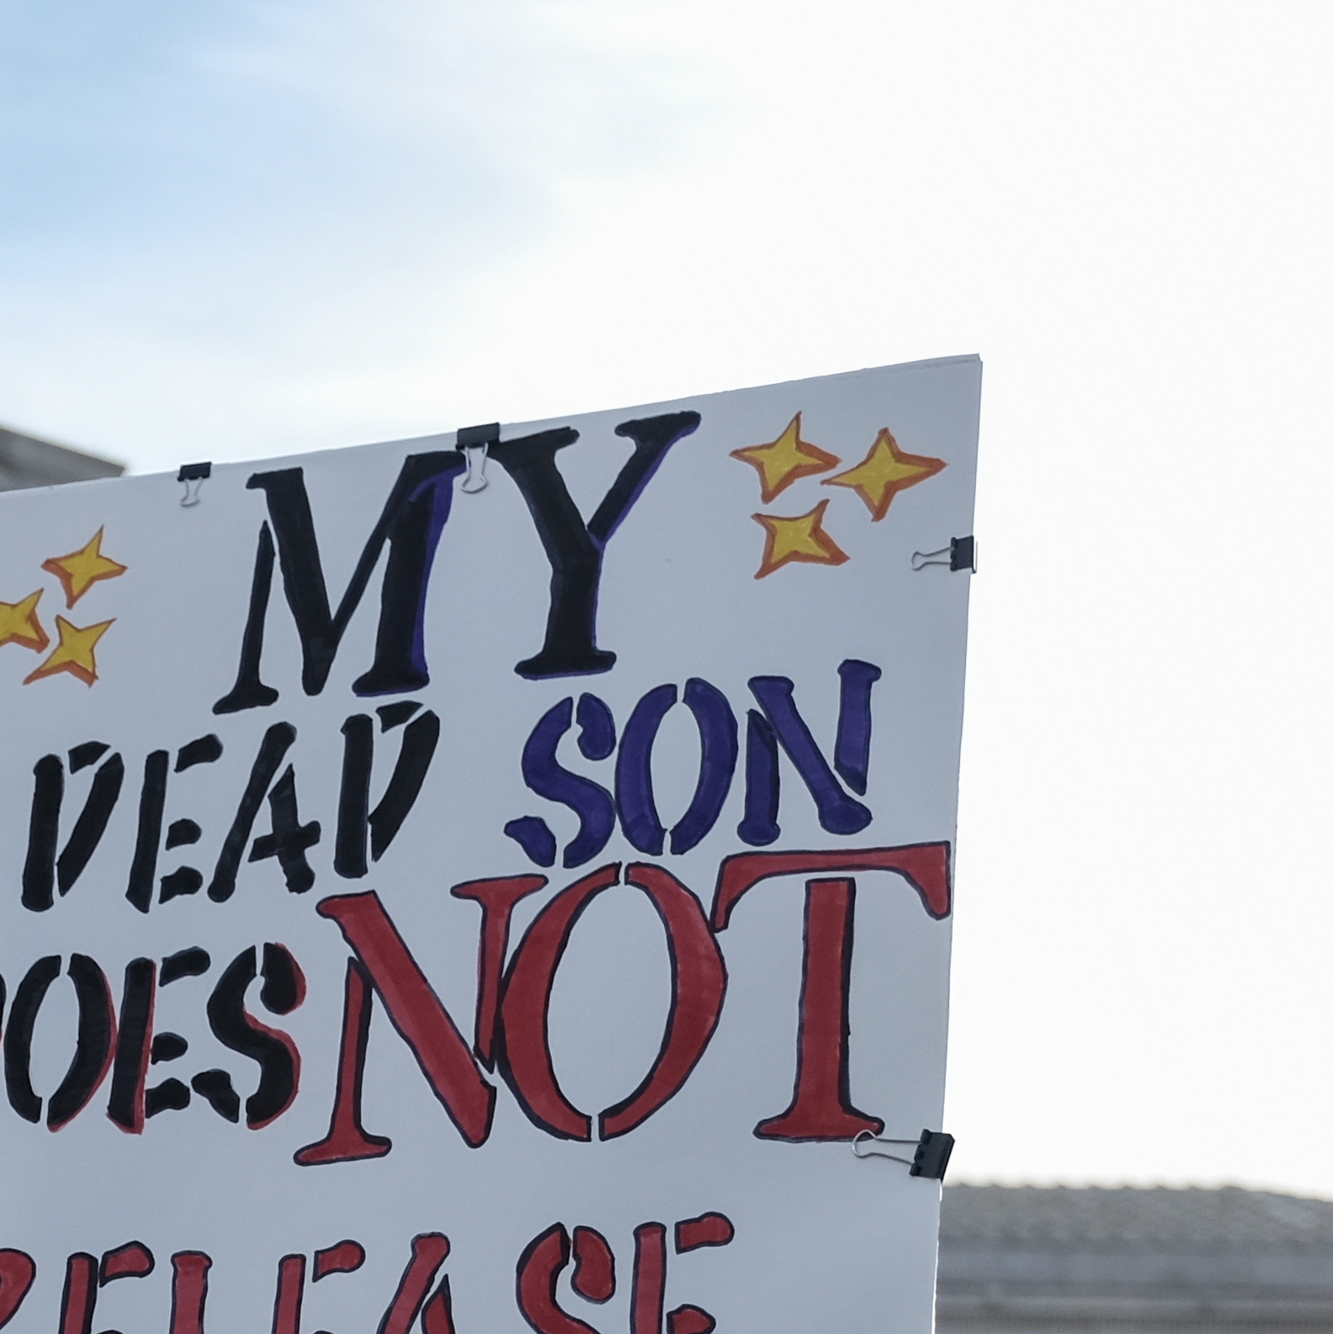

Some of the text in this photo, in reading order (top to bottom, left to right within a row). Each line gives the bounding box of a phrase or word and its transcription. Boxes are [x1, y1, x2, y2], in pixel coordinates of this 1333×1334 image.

[213, 411, 700, 714] MY
[21, 658, 881, 912] DEAD SON
[293, 841, 950, 1166] NOT
